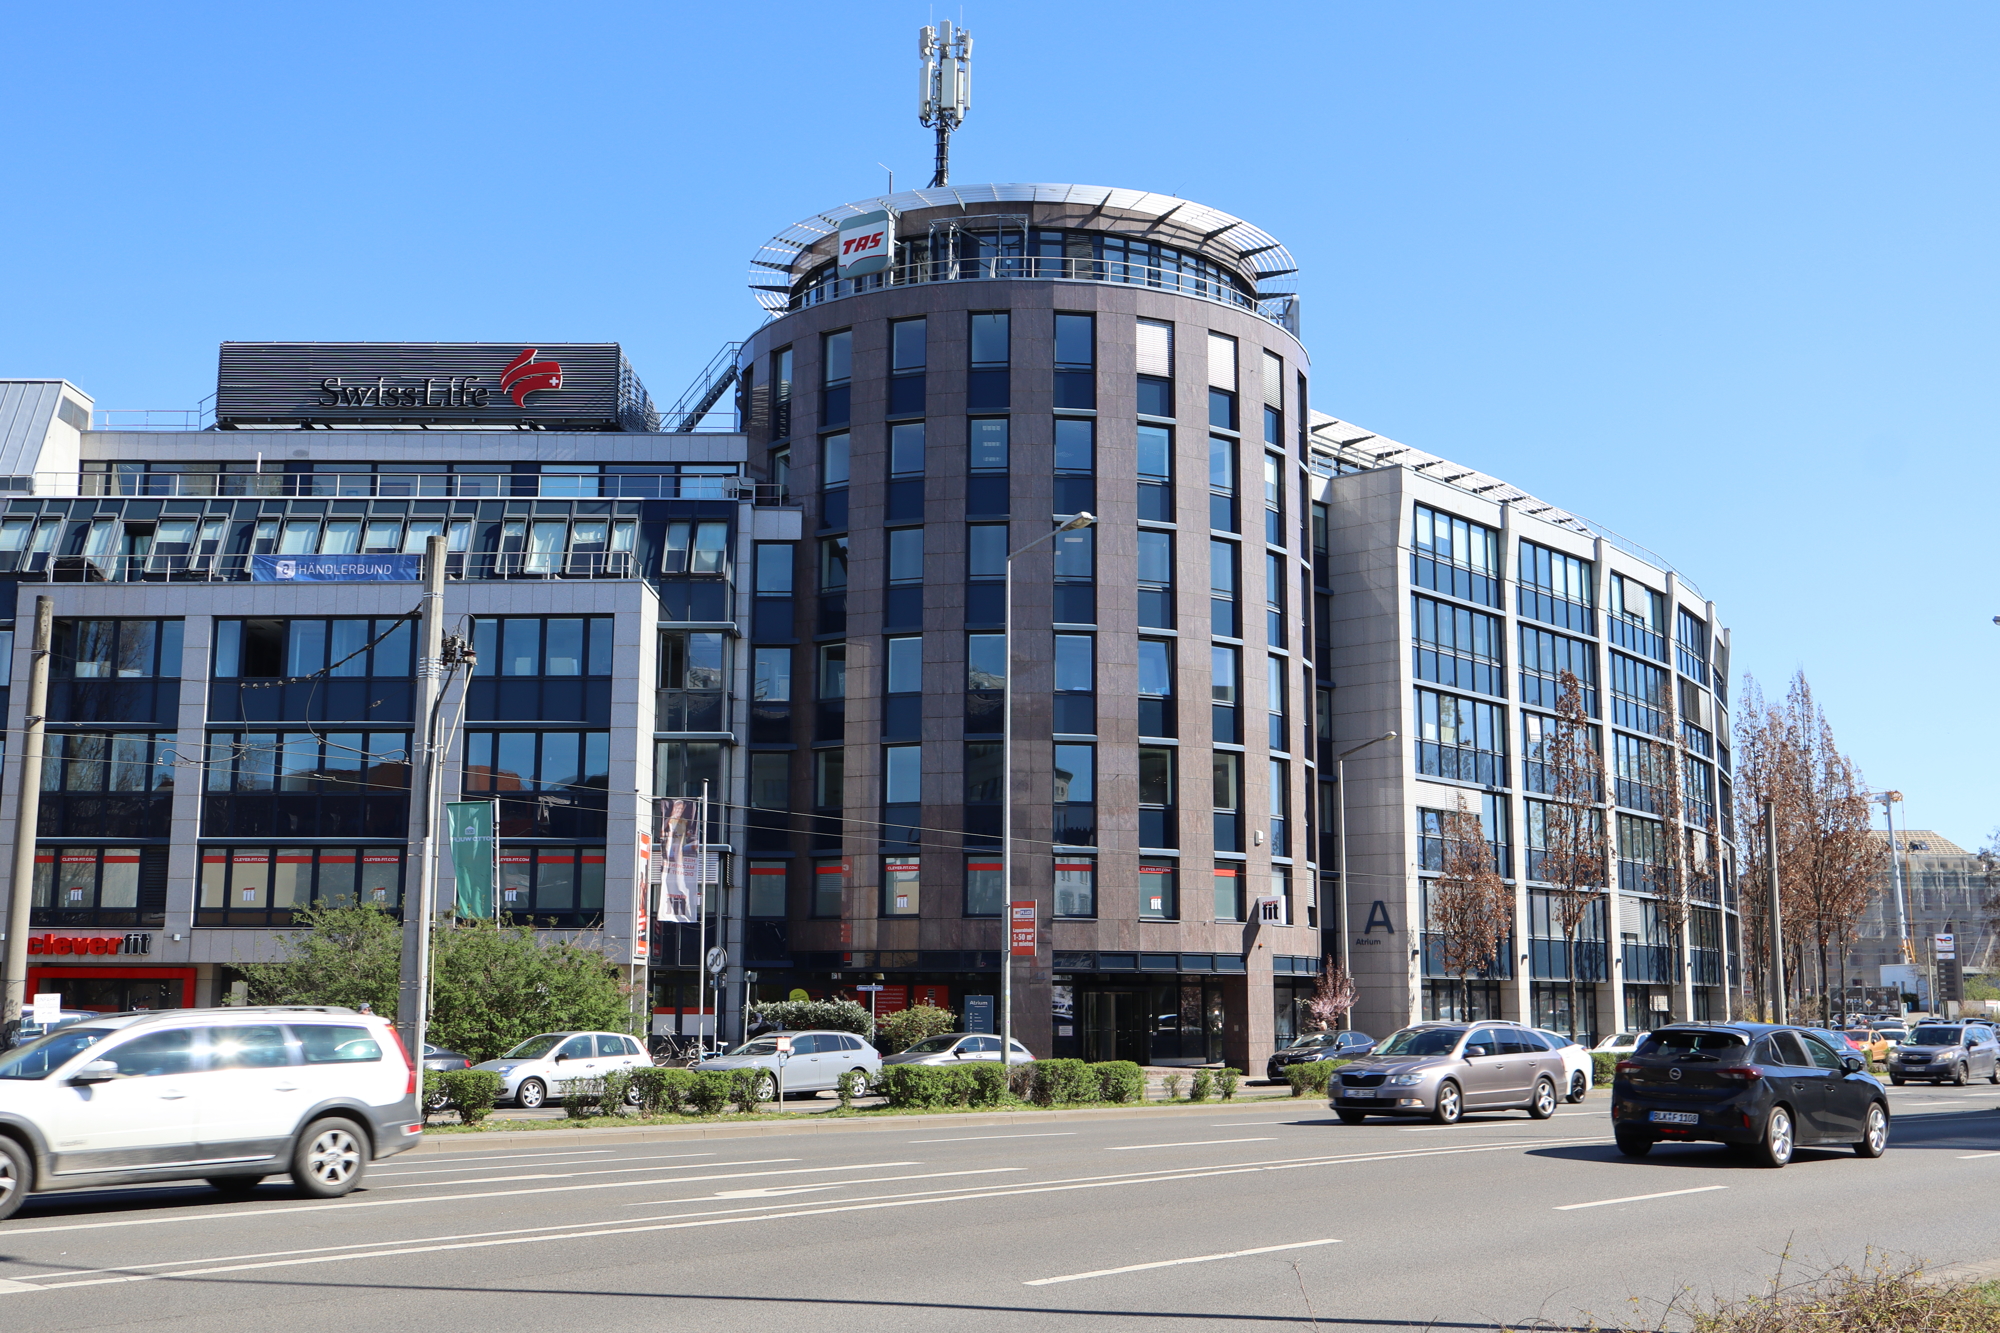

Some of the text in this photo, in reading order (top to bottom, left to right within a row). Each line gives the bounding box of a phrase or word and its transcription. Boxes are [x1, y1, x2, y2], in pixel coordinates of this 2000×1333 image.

[842, 231, 885, 256] TAS
[298, 562, 392, 575] HÄNDLERBUND
[70, 889, 82, 901] fit
[242, 889, 255, 901] fit
[504, 889, 517, 902] fit
[896, 896, 908, 908] fit
[1150, 898, 1162, 910] fit
[1262, 904, 1279, 920] fit
[1364, 900, 1395, 935] A
[27, 932, 150, 955] clever fit
[1355, 938, 1382, 946] Atrium
[709, 954, 722, 967] 30
[1679, 1113, 1698, 1122] 1108
